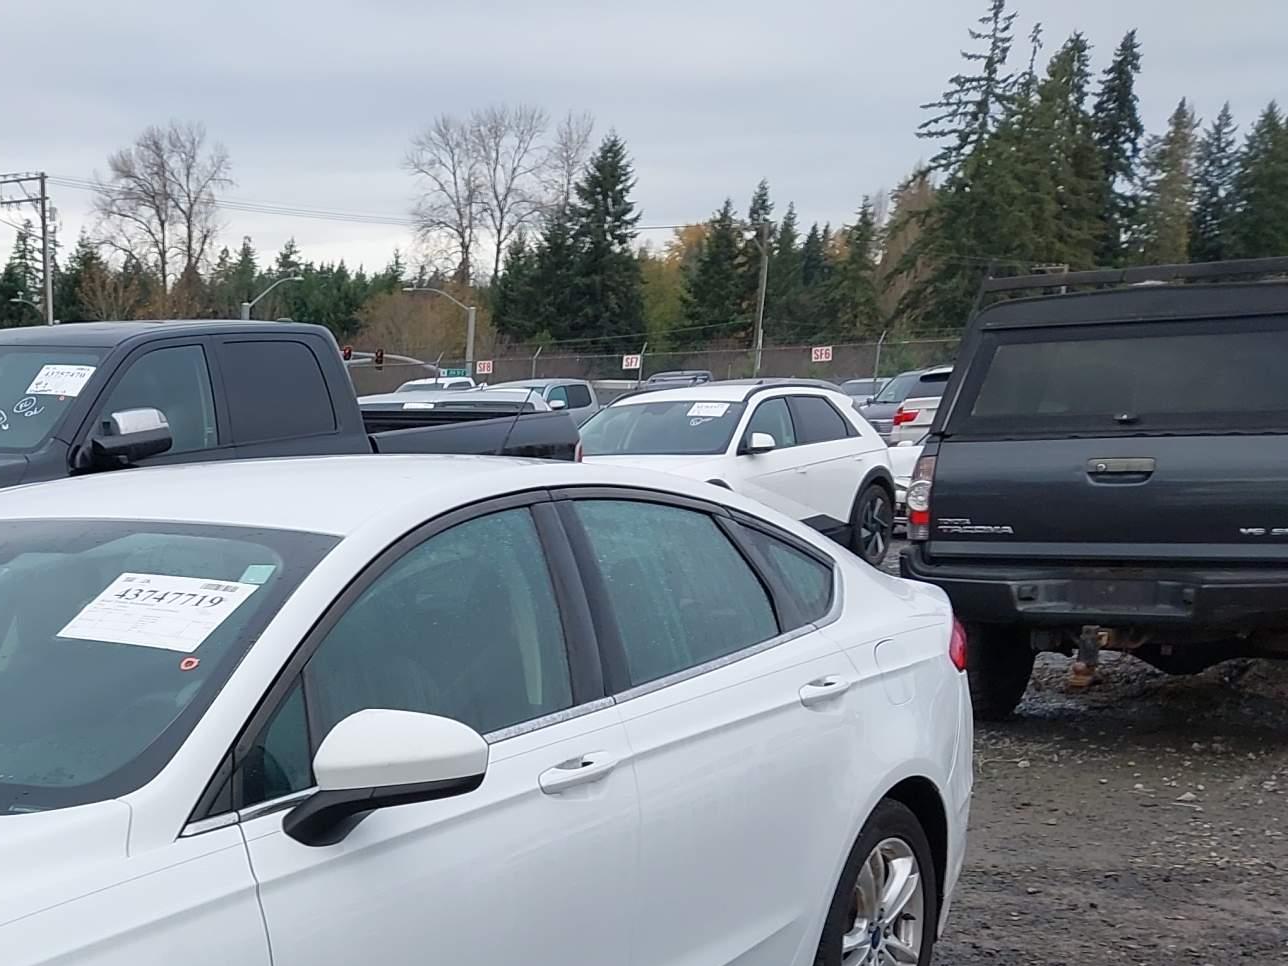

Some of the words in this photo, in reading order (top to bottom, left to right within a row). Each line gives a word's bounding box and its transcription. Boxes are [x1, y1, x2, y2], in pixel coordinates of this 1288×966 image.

[813, 348, 831, 360] SF6
[624, 356, 638, 368] SF7
[937, 525, 1014, 534] TACOMA
[114, 588, 224, 608] 43747719
